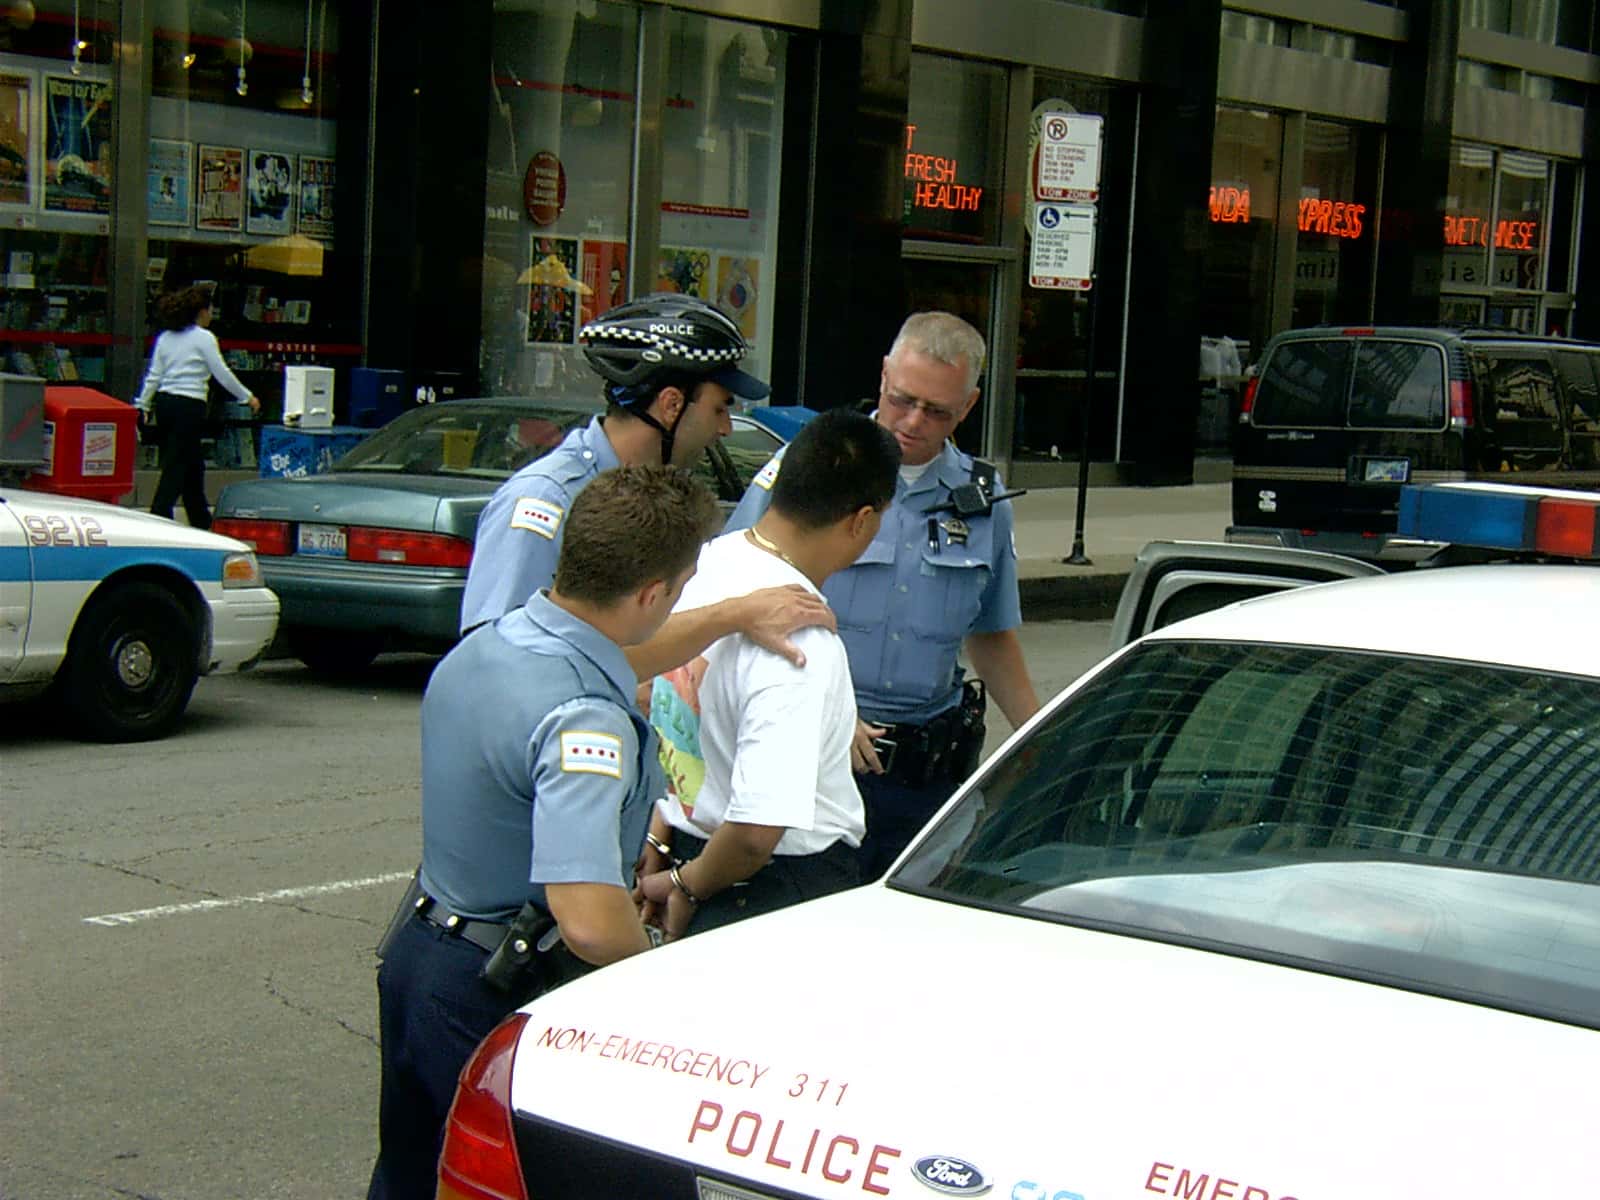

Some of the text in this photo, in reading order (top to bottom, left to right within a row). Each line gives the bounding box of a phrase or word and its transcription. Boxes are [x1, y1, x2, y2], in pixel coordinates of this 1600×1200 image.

[904, 153, 958, 183] FRESH
[915, 182, 983, 211] HEALTHY
[649, 323, 695, 336] POLICE
[24, 515, 109, 547] 9212
[536, 1026, 849, 1107] NON-EMERGENCY 311
[688, 1099, 901, 1196] POLICE
[926, 1158, 972, 1187] Ford
